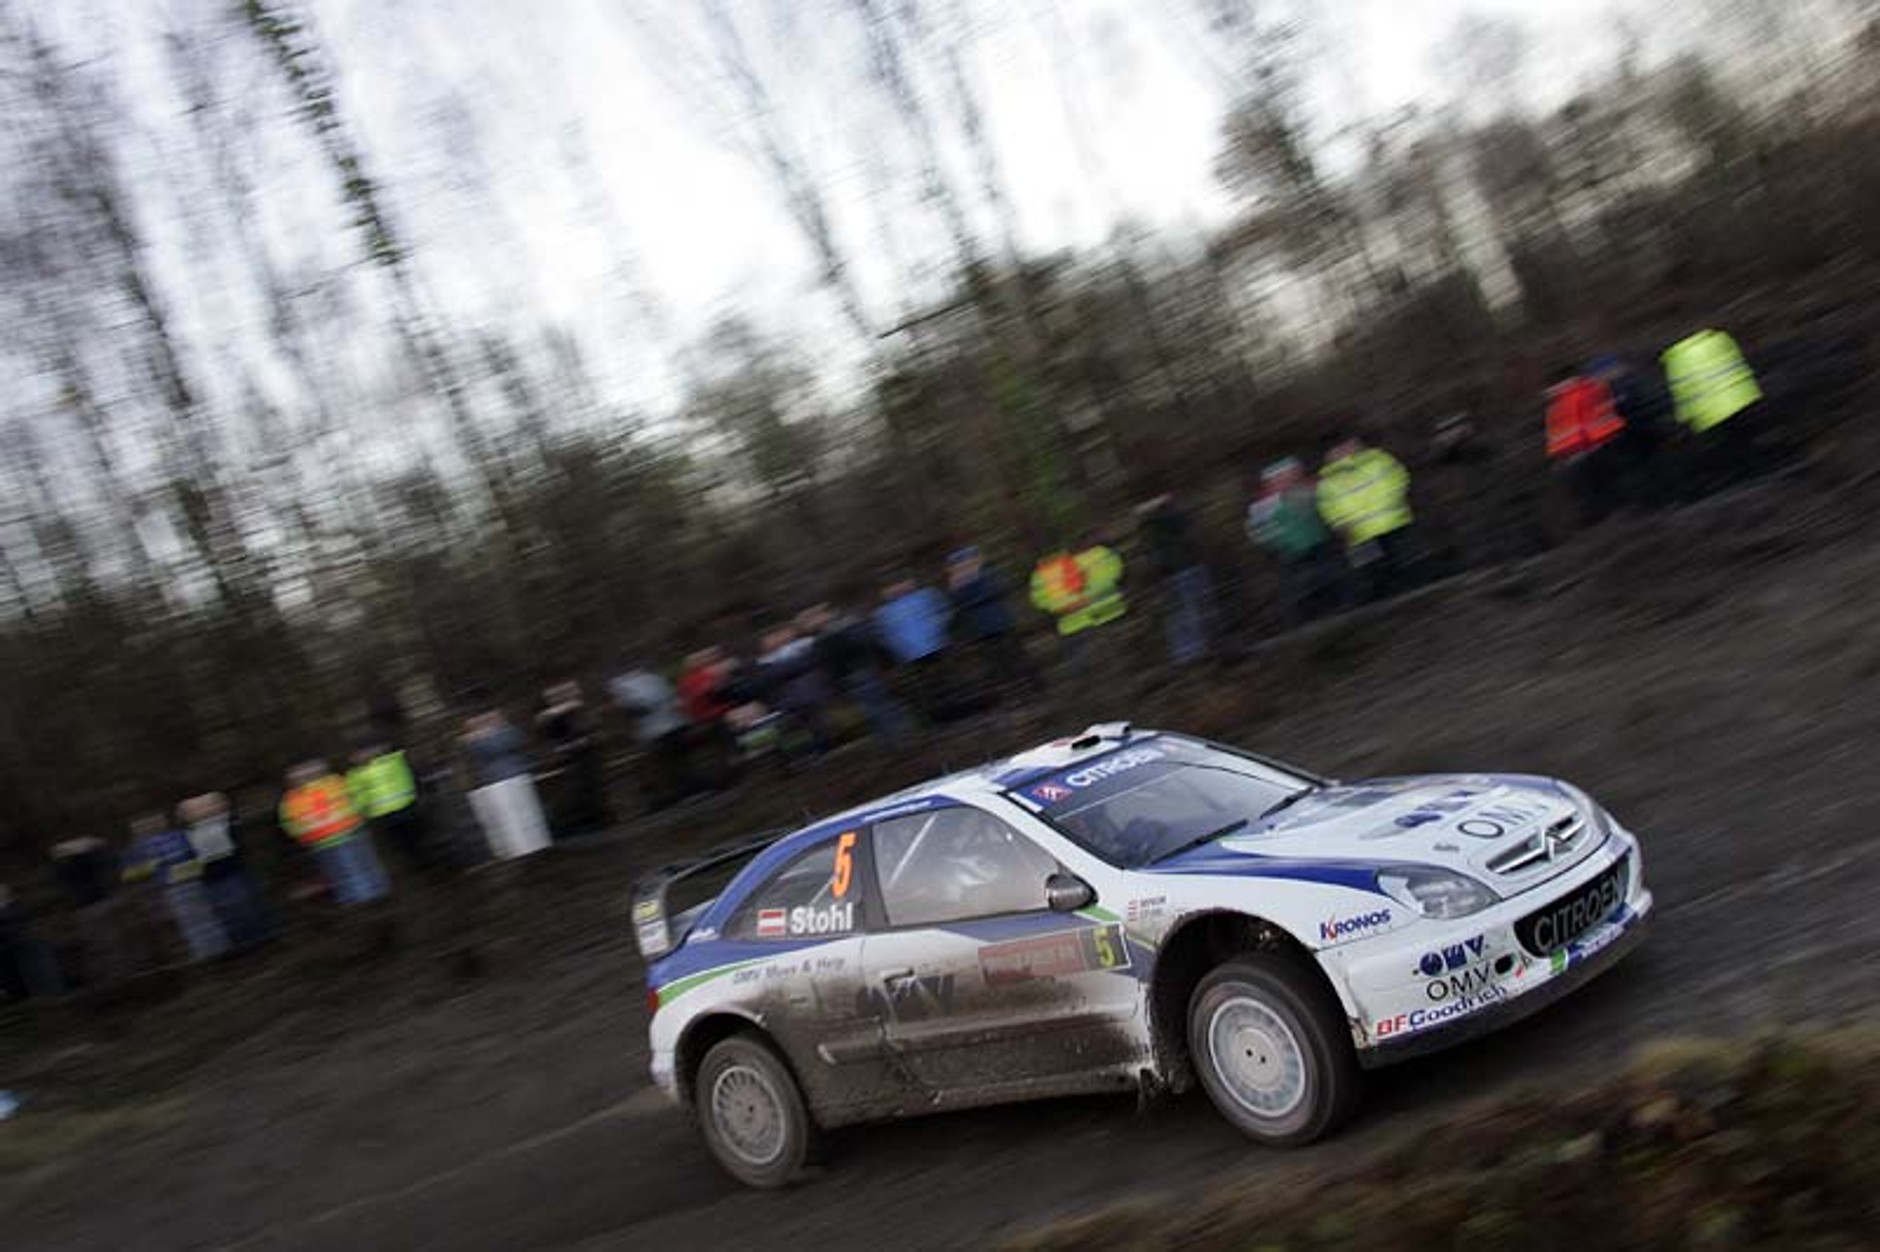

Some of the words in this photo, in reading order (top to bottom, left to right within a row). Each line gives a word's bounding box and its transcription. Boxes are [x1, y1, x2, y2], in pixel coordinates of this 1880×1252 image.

[832, 832, 857, 898] 5
[791, 901, 854, 935] Stohl
[1093, 926, 1116, 968] 5
[1426, 963, 1491, 1002] OMV
[1376, 983, 1506, 1036] BFGoodrich
